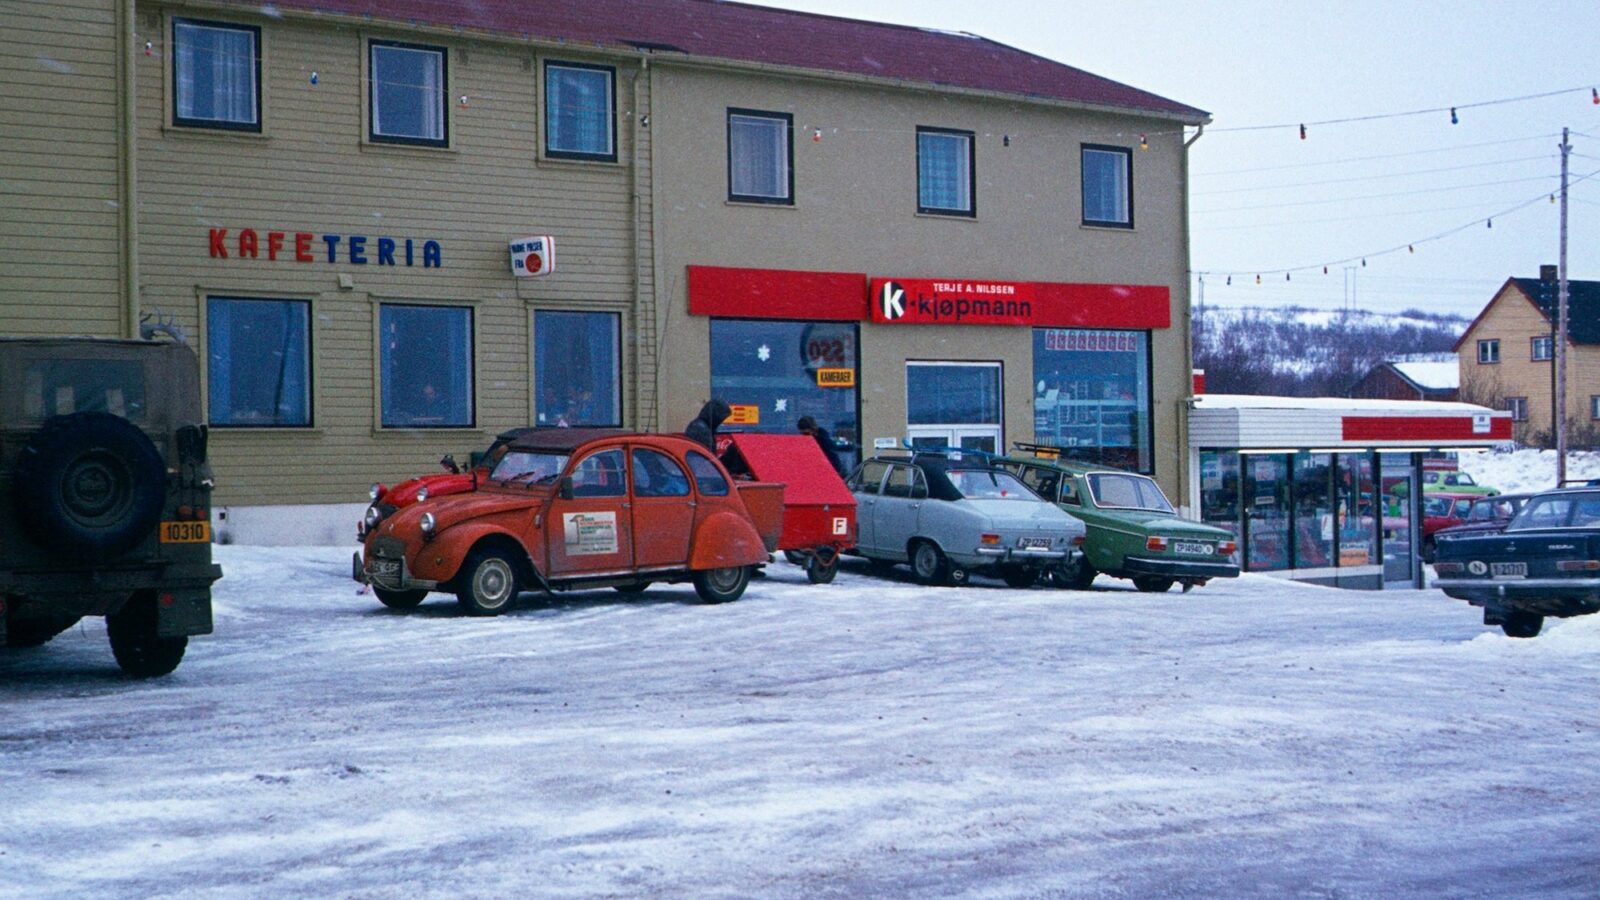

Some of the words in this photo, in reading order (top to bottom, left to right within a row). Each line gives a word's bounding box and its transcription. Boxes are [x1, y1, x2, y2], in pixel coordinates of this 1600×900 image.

[209, 228, 441, 268] KAFETERIA
[933, 283, 963, 293] TERJE
[976, 285, 1015, 294] NILSSEN
[820, 371, 851, 383] KAMERAER
[167, 524, 204, 540] 10310
[836, 519, 844, 533] F
